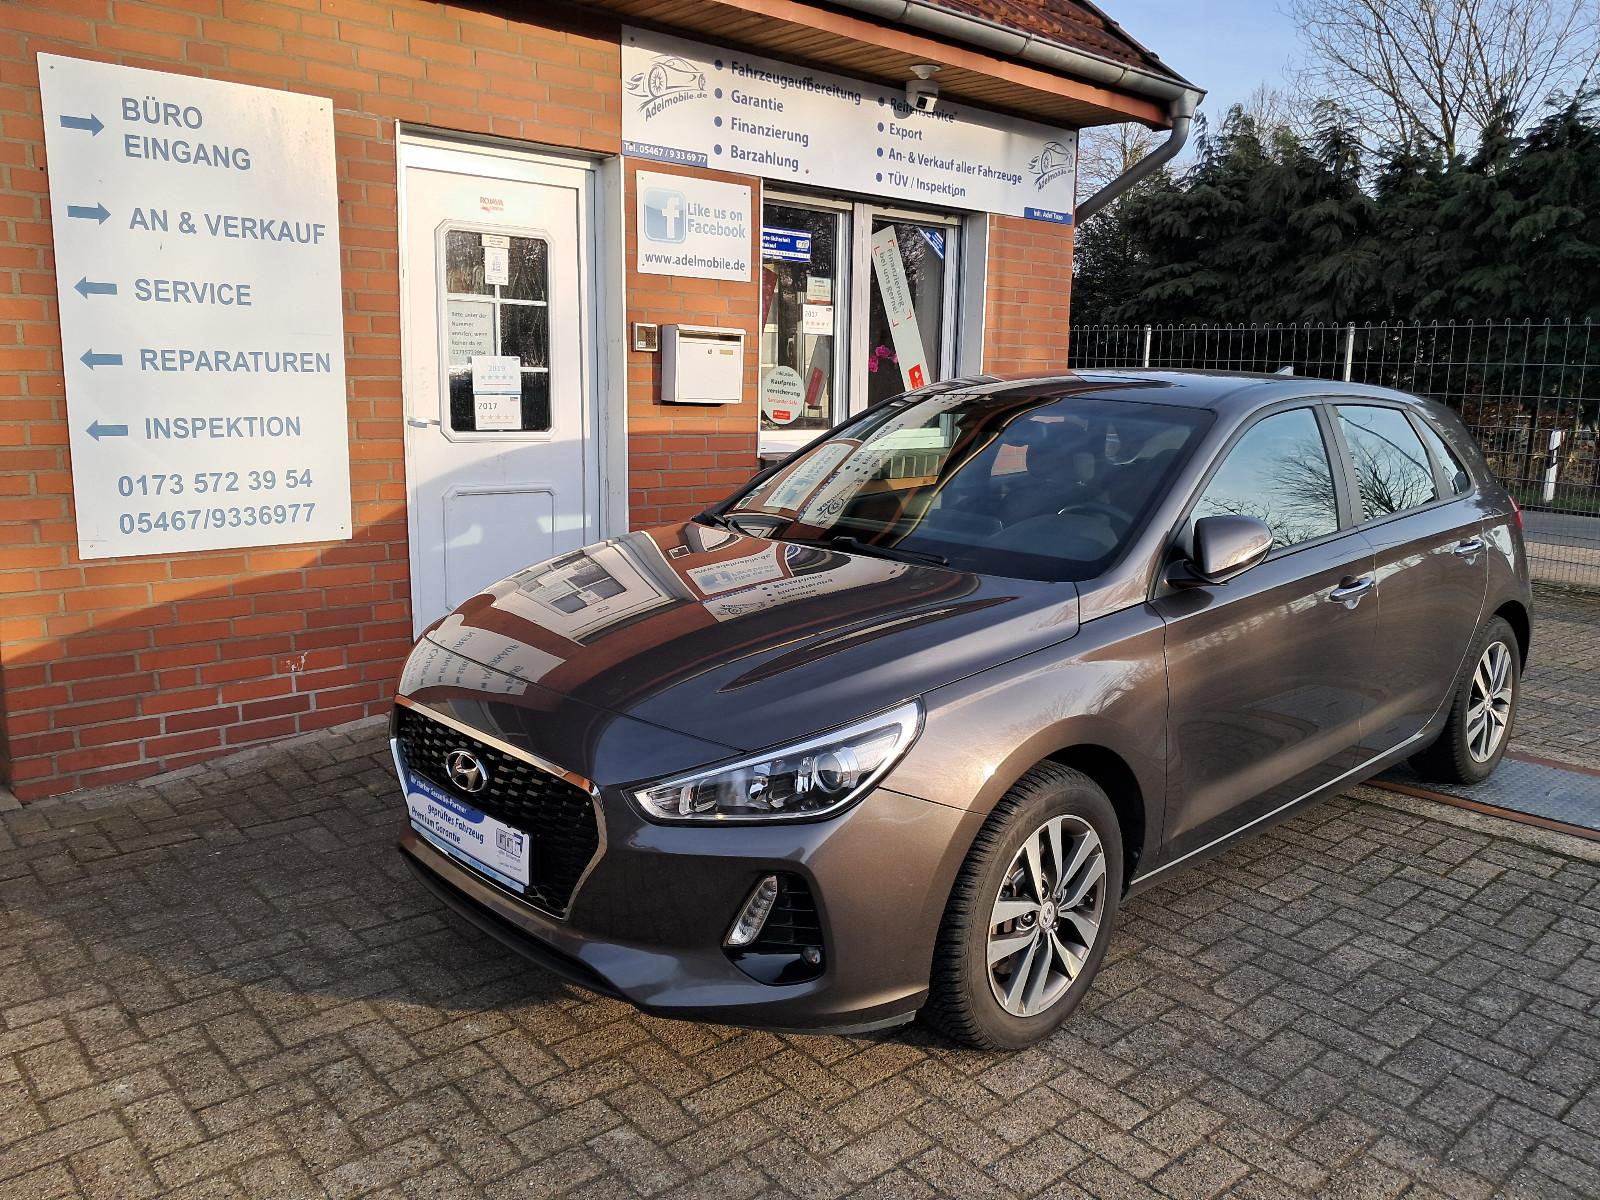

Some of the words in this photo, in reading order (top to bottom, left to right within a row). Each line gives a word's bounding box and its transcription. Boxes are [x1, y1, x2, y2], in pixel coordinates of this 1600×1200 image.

[731, 61, 862, 105] Fahrzeugaufbereitung
[121, 95, 204, 130] BÜRO
[645, 91, 708, 122] Adelmobile.de
[731, 90, 784, 113] Garantie
[731, 117, 809, 147] Finanzierung
[889, 122, 923, 141] Export
[124, 134, 251, 171] EINGANG
[624, 142, 638, 153] Tel.
[639, 145, 664, 157] 05467
[669, 150, 675, 158] 9
[675, 151, 685, 160] 33
[686, 153, 697, 162] 69
[697, 154, 707, 163] 77
[730, 145, 799, 173] Barzahlung
[888, 147, 907, 163] An-
[908, 151, 915, 164] &
[917, 154, 955, 171] Verkauf
[955, 159, 976, 175] aller
[977, 165, 1023, 186] Fahrzeuge
[888, 171, 909, 189] TÜV
[916, 177, 966, 198] Inspektion
[129, 207, 169, 232] AN
[178, 211, 198, 234] &
[203, 213, 326, 245] VERKAUF
[687, 202, 711, 218] Like
[714, 208, 726, 220] us
[729, 211, 743, 222] on
[687, 219, 746, 239] Facebook
[645, 253, 746, 272] www.adelmobile.de
[134, 278, 252, 306] SERVICE
[139, 348, 331, 374] REPARATUREN
[478, 402, 498, 410] 2017
[145, 416, 302, 440] INSPEKTION
[117, 473, 185, 498] 0173
[193, 471, 240, 495] 572
[248, 469, 277, 492] 39
[285, 468, 313, 490] 54
[119, 502, 316, 535] 05467/9336977
[411, 804, 435, 829] Premium
[435, 821, 461, 844] Garantie
[427, 804, 455, 826] geprüftes
[455, 817, 484, 845] Fahrzeug
